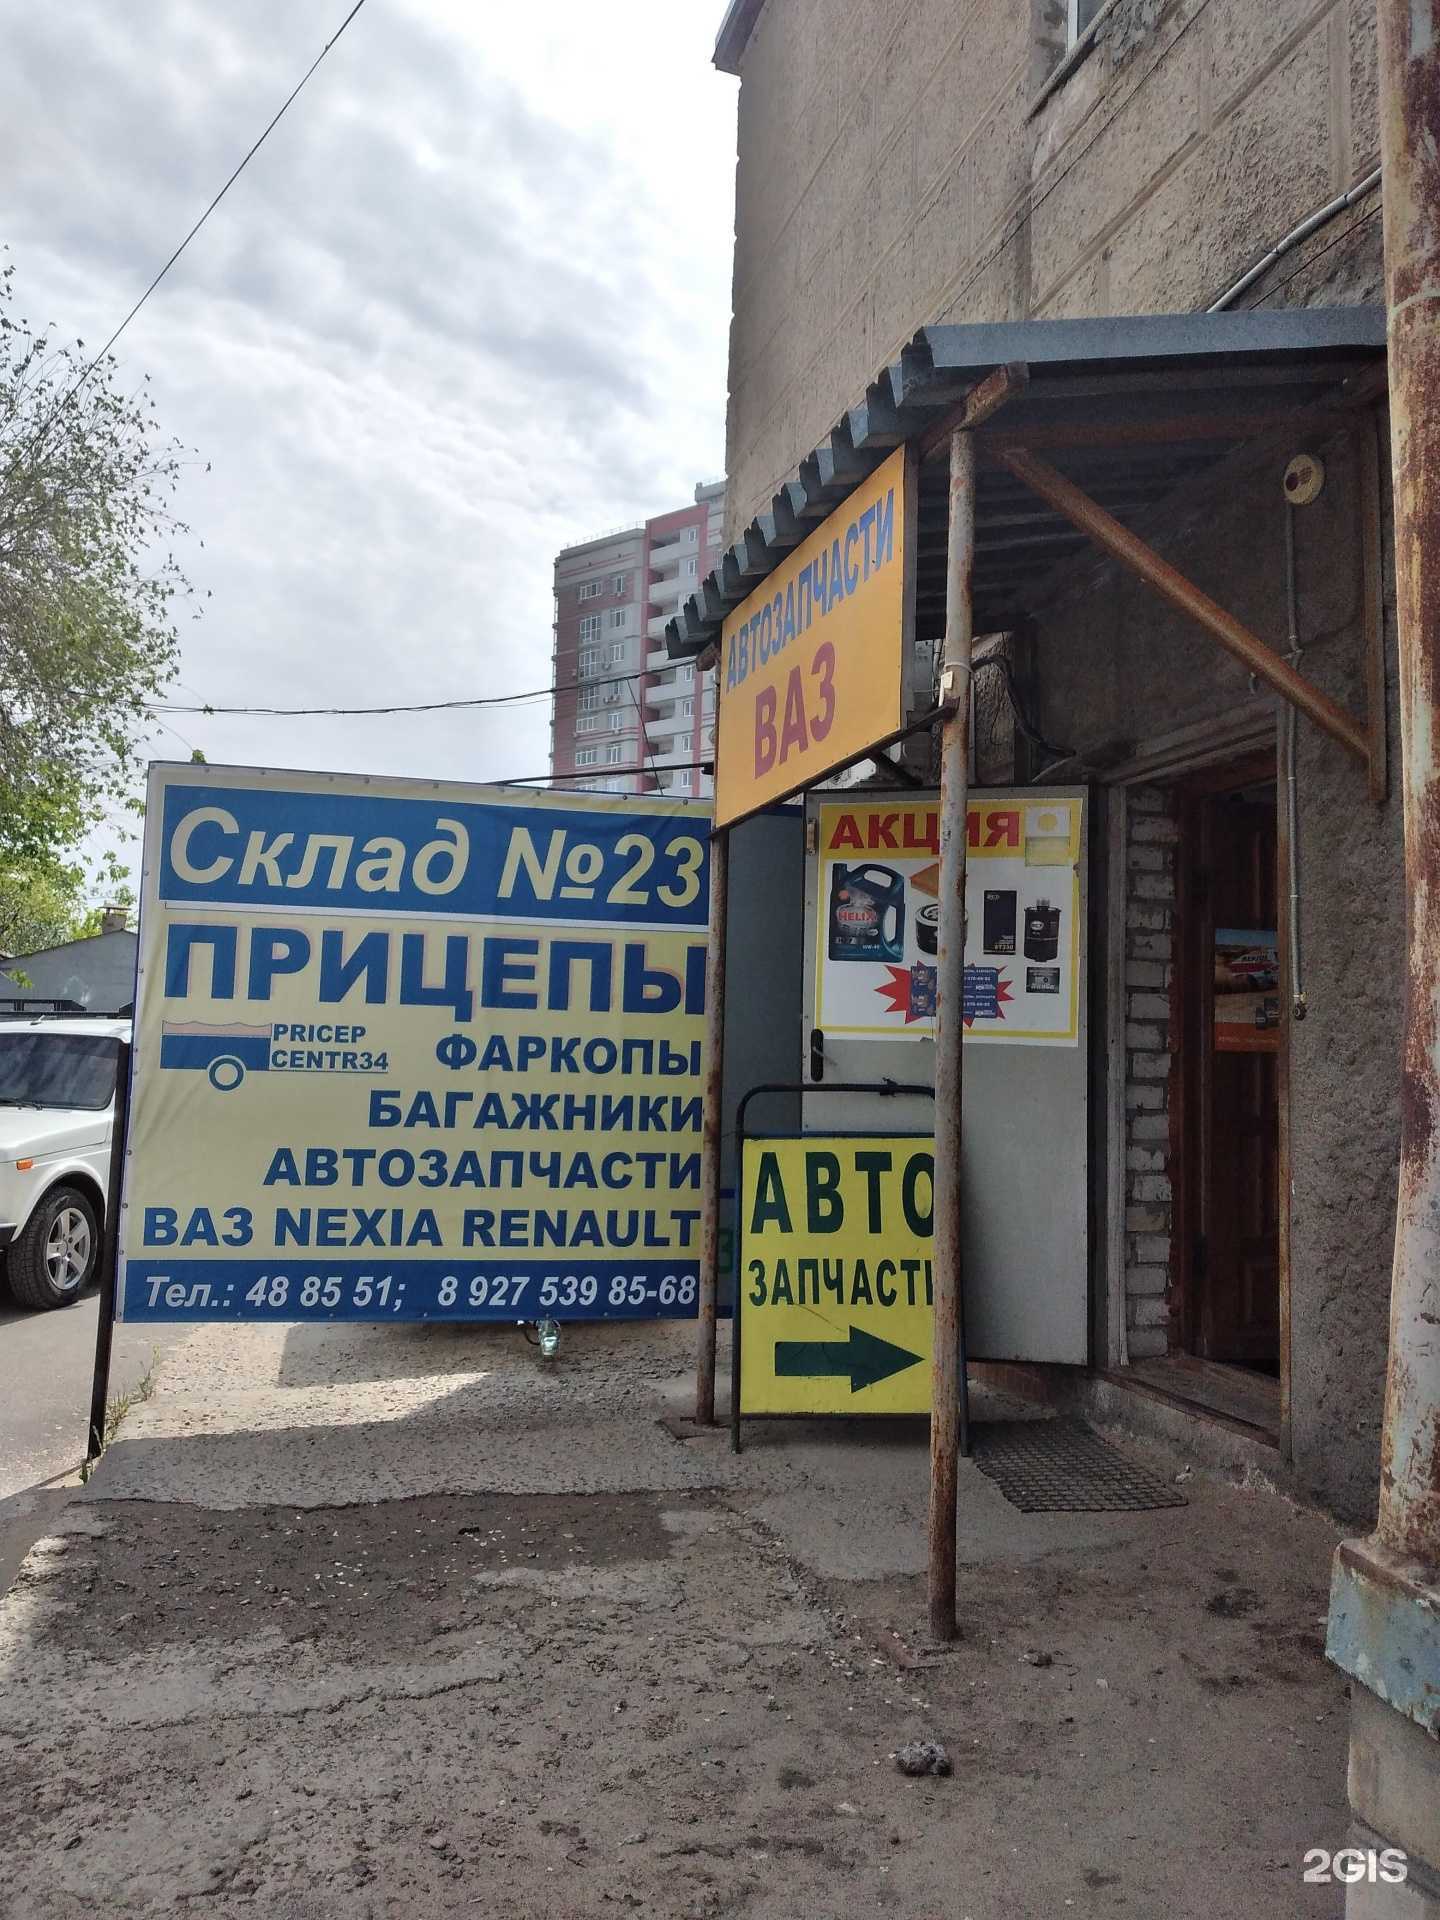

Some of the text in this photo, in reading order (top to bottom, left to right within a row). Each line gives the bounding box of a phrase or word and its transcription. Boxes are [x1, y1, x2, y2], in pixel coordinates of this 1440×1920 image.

[725, 488, 895, 694] АВТОЗАПЧАСТИ
[754, 641, 836, 780] ВАЗ
[170, 806, 704, 907] Склад №23
[165, 923, 706, 1022] ПРИЦЕПЫ
[272, 1023, 367, 1043] PRICEP
[271, 1050, 389, 1070] CENTR34
[436, 1033, 702, 1076] ФАРКОПЫ
[368, 1090, 703, 1132] БАГАЖНИКИ
[263, 1147, 702, 1189] АВТОЗАПЧАСТИ
[750, 1151, 935, 1238] АВТО
[143, 1207, 701, 1248] ВАЗ NEXIA RENAULT
[146, 1275, 697, 1312] Тел.: 48 85 51; 8 927 539 85-68
